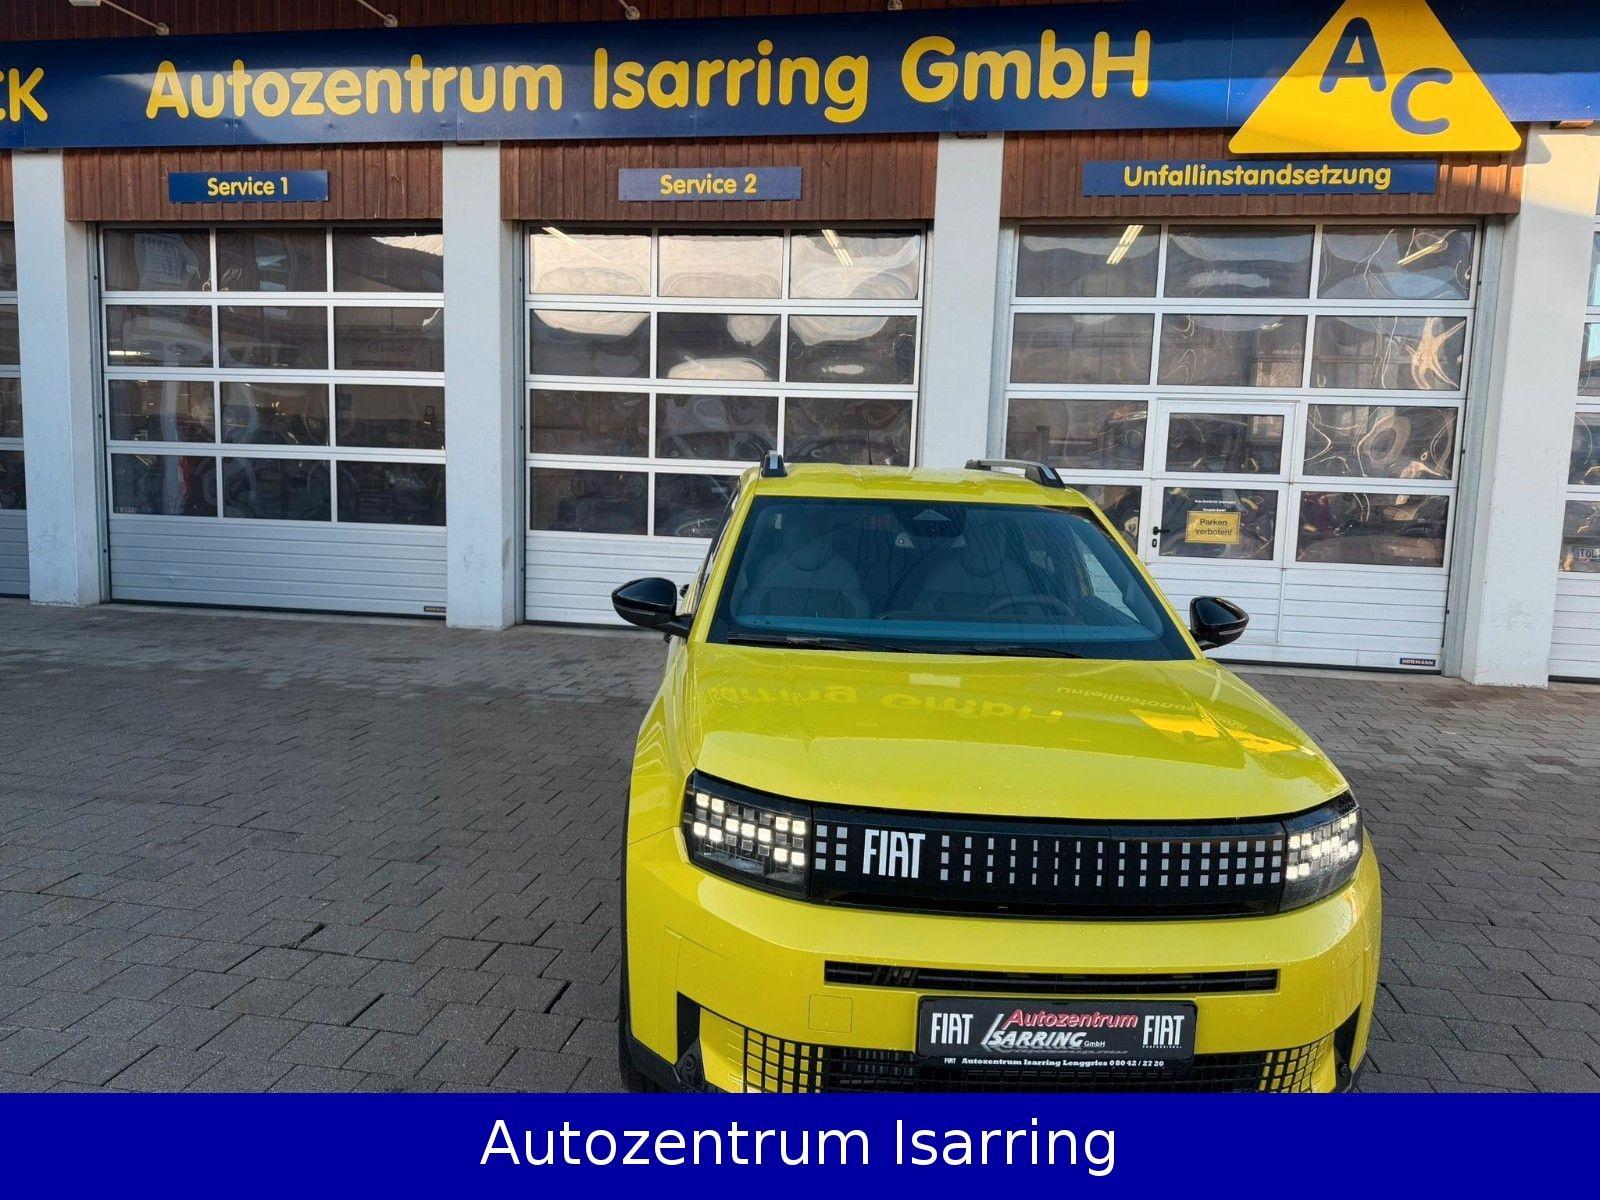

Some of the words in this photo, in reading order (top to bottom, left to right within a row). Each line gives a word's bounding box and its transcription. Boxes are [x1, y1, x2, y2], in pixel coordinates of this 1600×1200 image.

[146, 54, 563, 119] Autozentrum
[593, 39, 869, 123] Isarring
[901, 29, 1151, 104] GmbH
[0, 67, 48, 122] K
[207, 177, 275, 196] Service
[279, 177, 289, 195] 1
[660, 175, 738, 195] Service
[744, 173, 758, 194] 2
[1123, 163, 1392, 191] Unfallinstandsetzung
[1200, 518, 1228, 526] Parken
[863, 828, 926, 878] FIAT
[930, 1012, 973, 1045] FIAT
[1001, 1009, 1138, 1030] Autozentrum
[1142, 1015, 1185, 1046] FIAT
[961, 1058, 1022, 1066] Autozentrum
[1023, 1059, 1061, 1068] Isarring
[1062, 1060, 1108, 1068] Lenggries
